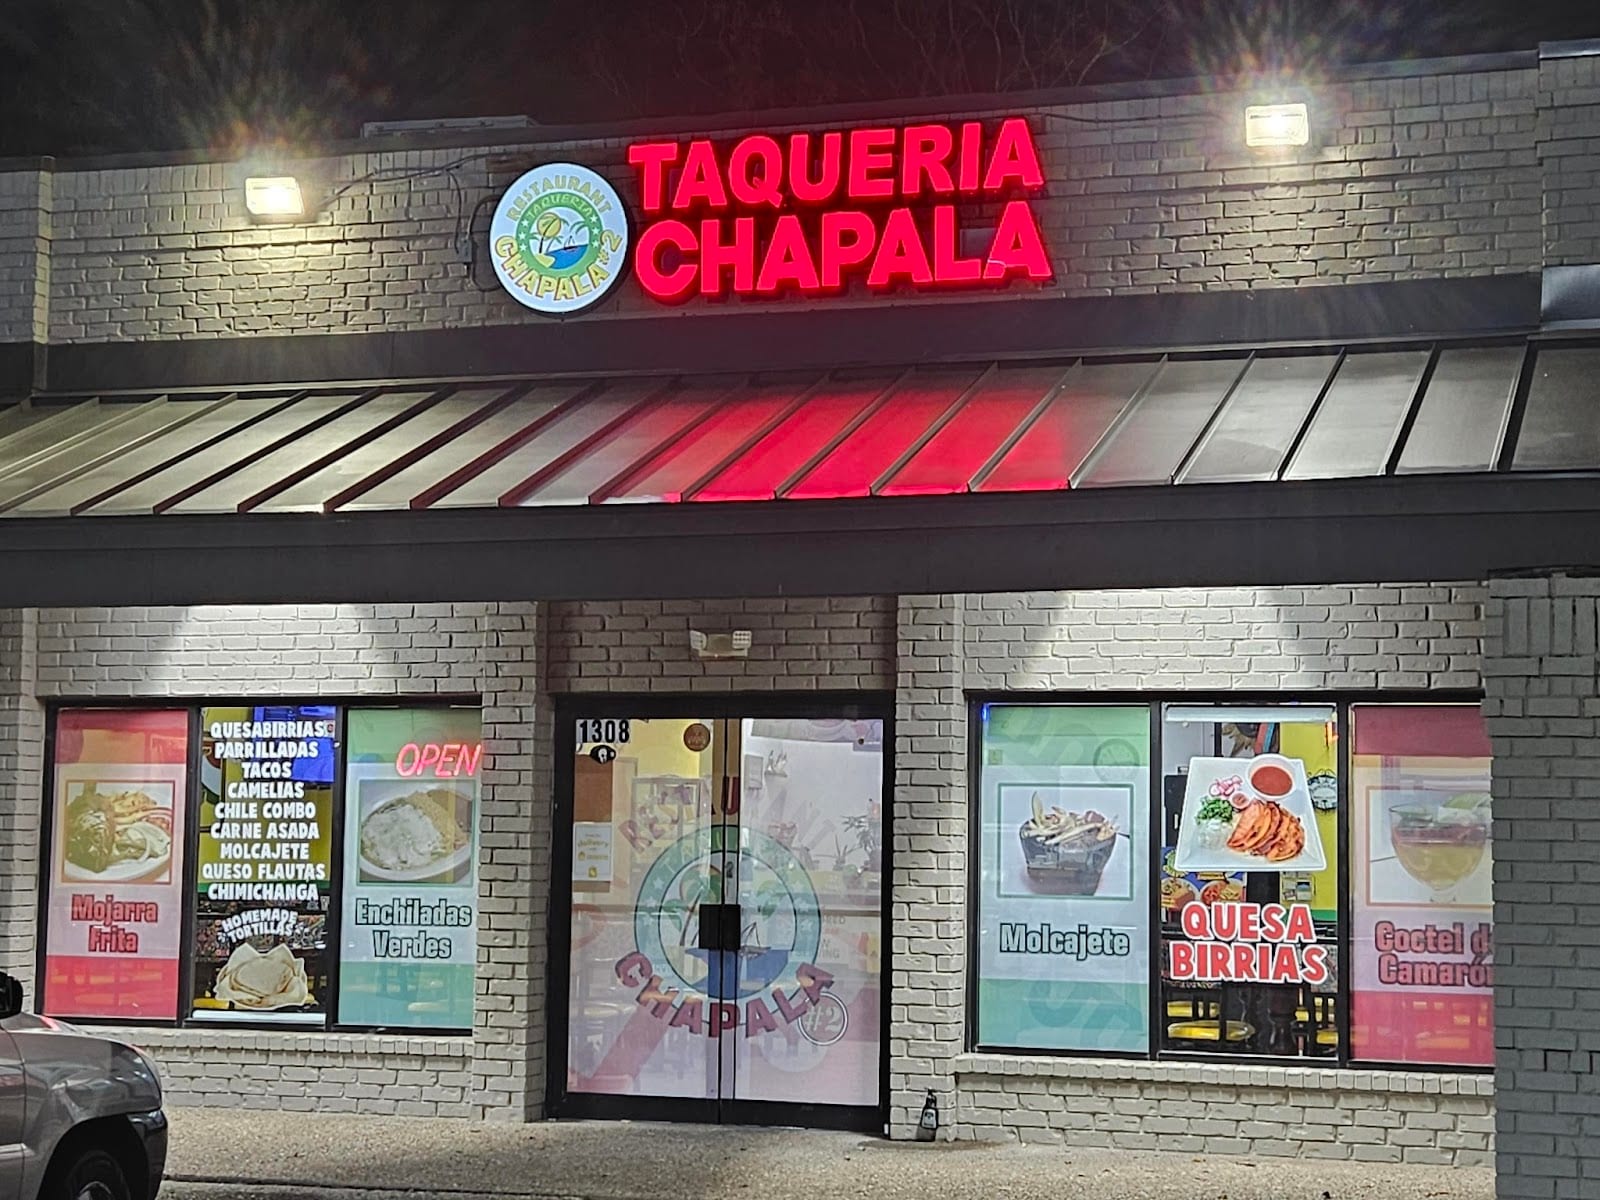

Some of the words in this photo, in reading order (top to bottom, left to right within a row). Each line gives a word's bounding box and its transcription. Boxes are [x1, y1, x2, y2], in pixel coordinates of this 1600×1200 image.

[628, 117, 1044, 210] TAQUERIA
[506, 175, 612, 222] RESTAURANT
[528, 193, 593, 218] TAQUERIA
[635, 200, 1053, 297] CHAPALA
[495, 235, 610, 301] CHAPALA
[210, 720, 325, 739] QUESABIRRIAS
[579, 720, 630, 744] 1308
[214, 741, 319, 759] PARRILLADAS
[395, 743, 481, 777] OPEN
[241, 761, 292, 779] TACOS
[227, 781, 305, 799] CAMELIAS
[214, 801, 258, 820] CHILE
[262, 801, 317, 820] COMBO
[210, 822, 262, 840] CARNE
[266, 822, 320, 840] ASADA
[220, 842, 310, 860] MOLCAJETE
[202, 863, 253, 881] QUESO
[258, 863, 326, 881] FLAUTAS
[207, 882, 320, 901] CHIMICHANGA
[71, 893, 159, 928] Mojarra
[221, 908, 298, 932] HOMEMADE
[355, 897, 473, 927] Enchiladas
[1181, 901, 1317, 944] QUESA
[88, 924, 139, 953] Frita
[226, 921, 295, 943] TORTILLAS
[372, 929, 453, 959] Verdes
[999, 922, 1131, 961] Molcajete
[1375, 920, 1465, 955] Coctel
[1470, 922, 1493, 956] d
[1169, 941, 1329, 985] BIRRIAS
[614, 951, 834, 1038] CHAPALA
[804, 1004, 841, 1035] #2
